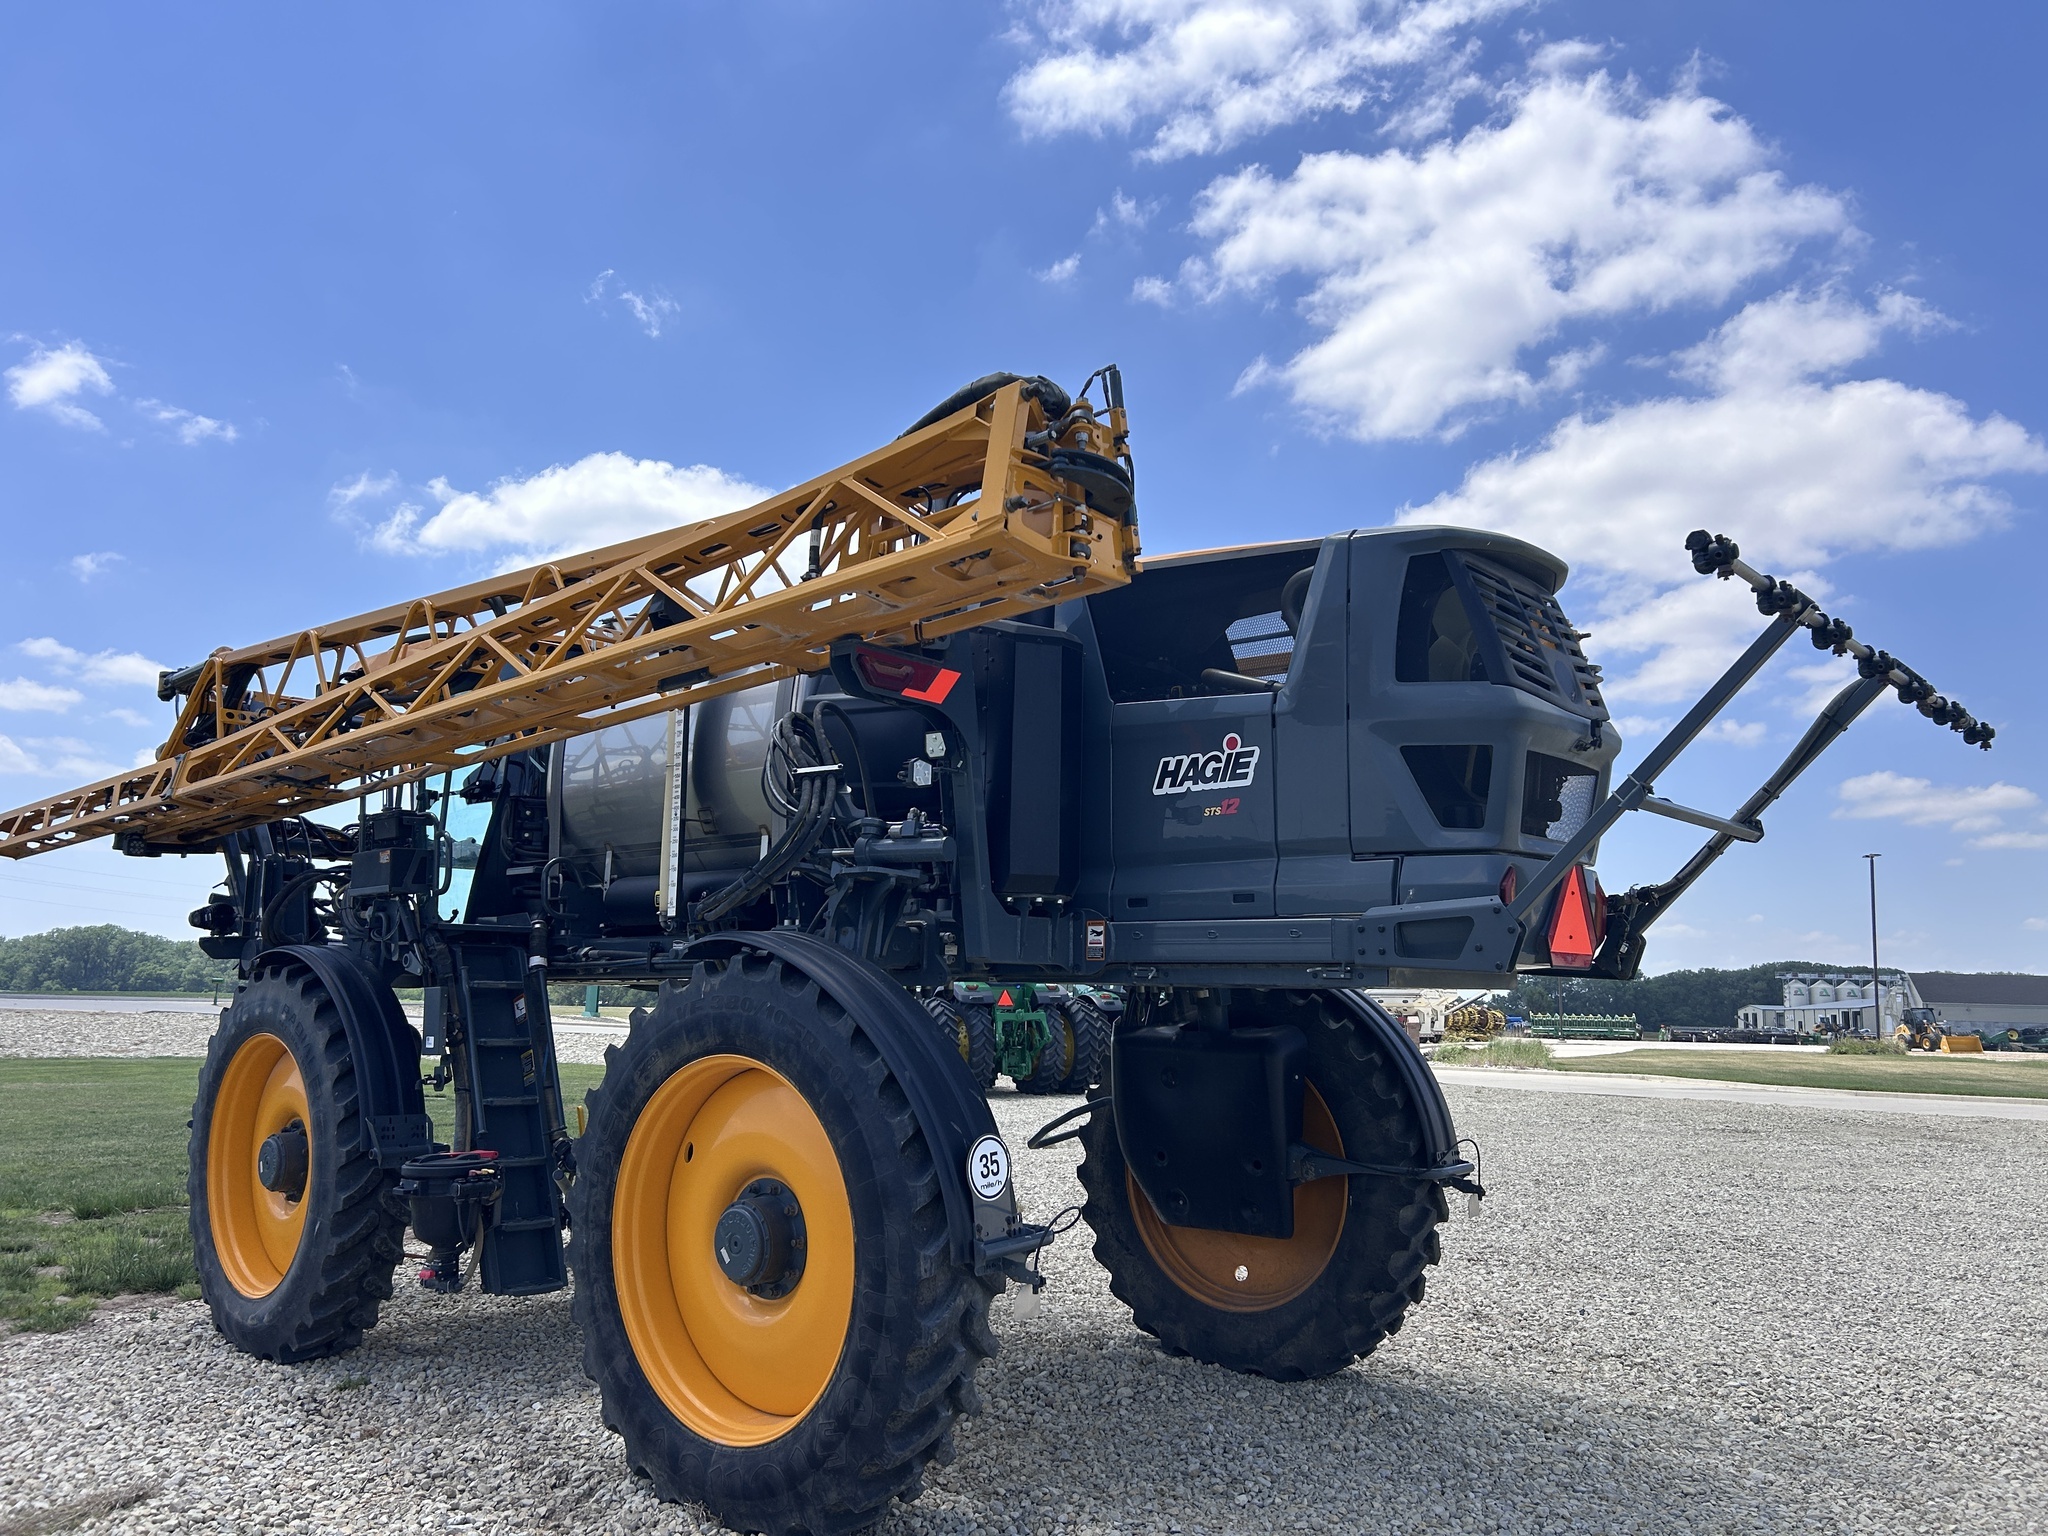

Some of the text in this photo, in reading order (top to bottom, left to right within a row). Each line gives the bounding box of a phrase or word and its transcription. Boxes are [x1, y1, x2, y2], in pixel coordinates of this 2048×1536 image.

[1153, 733, 1260, 795] HAGIE
[1203, 797, 1240, 817] STS12
[979, 1151, 1000, 1179] 35
[980, 1180, 1003, 1191] mile/h
